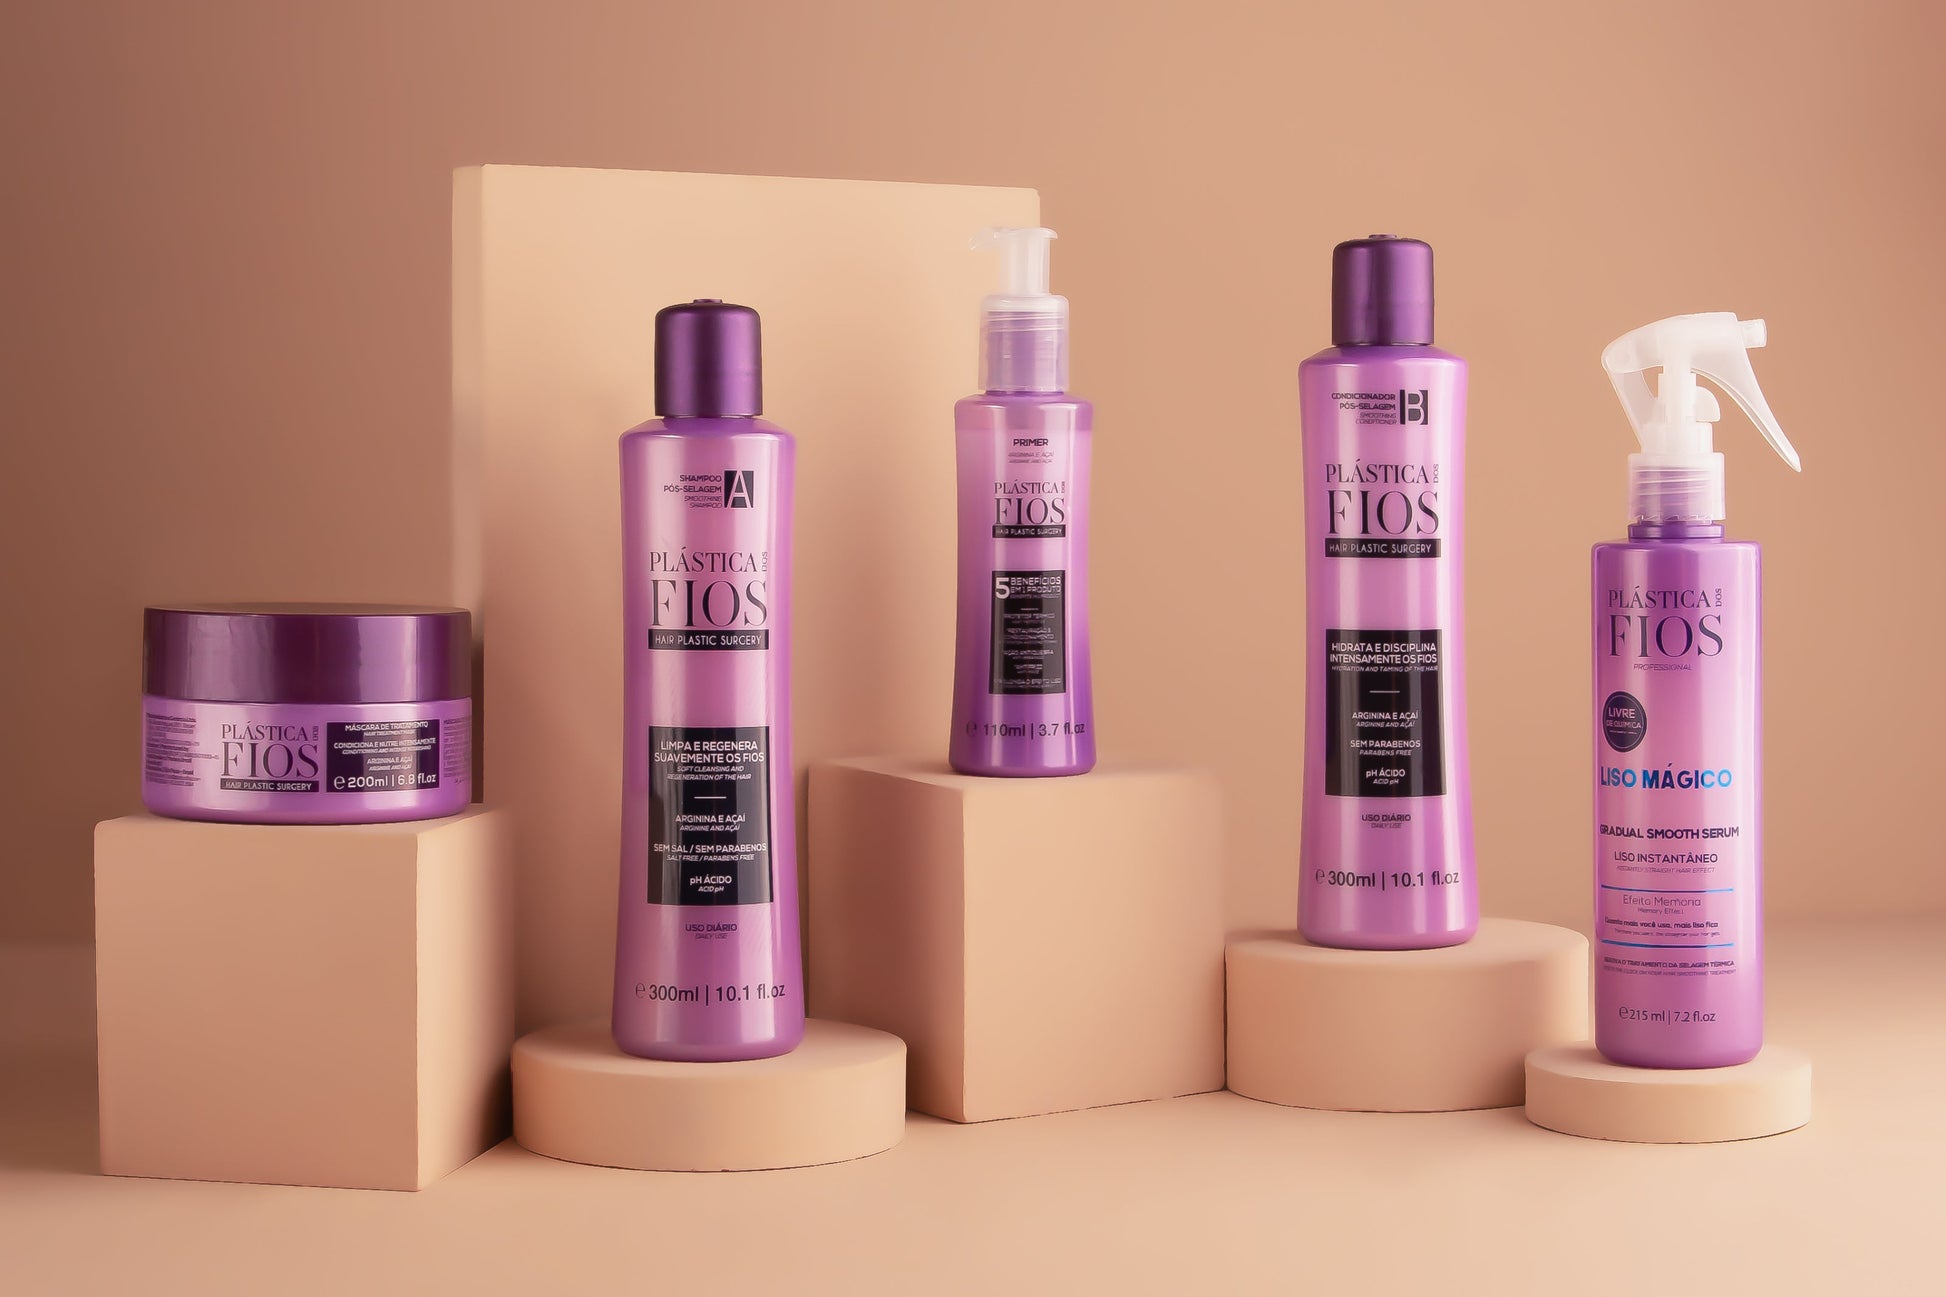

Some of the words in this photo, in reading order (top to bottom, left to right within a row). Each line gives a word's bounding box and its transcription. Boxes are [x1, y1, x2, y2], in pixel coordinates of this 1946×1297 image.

[1340, 402, 1395, 410] PÓS-SELAGEM
[1400, 390, 1428, 425] B
[1326, 459, 1429, 483] PLÁSTICA
[724, 471, 753, 508] A
[995, 479, 1058, 494] PLÁSTICA
[995, 498, 1064, 524] FIOS
[1328, 490, 1439, 534] FIOS
[1351, 544, 1387, 553] PLASTIC
[1392, 544, 1431, 553] SURGERY
[650, 547, 757, 572] PLÁSTICA
[996, 578, 1010, 599] 5
[1608, 585, 1711, 608] PLÁSTICA
[651, 580, 767, 626] FIOS
[656, 636, 674, 645] HAIR
[678, 636, 716, 645] PLASTIC
[721, 636, 761, 645] SURGERY
[1610, 615, 1722, 657] FIOS
[1332, 643, 1373, 652] HIDRATA
[1375, 644, 1381, 652] E
[1383, 643, 1436, 652] DISCIPLINA
[1330, 654, 1401, 663] INTENSAMENTE
[1402, 655, 1416, 663] OS
[1418, 654, 1437, 663] FIOS
[1399, 710, 1418, 721] AÇAÍ
[1609, 708, 1635, 718] LIVRE
[222, 721, 308, 741] PLÁSTICA
[391, 721, 428, 729] TRATAMENTO
[984, 724, 1025, 736] 110ml
[1039, 724, 1058, 736] 3.7
[661, 742, 692, 751] LIMPA
[694, 742, 700, 750] E
[703, 741, 758, 751] REGENERA
[1351, 740, 1367, 748] SEM
[1369, 740, 1421, 748] PARABENOS
[222, 742, 318, 778] FIOS
[655, 753, 724, 763] SUAVEMENTE
[726, 753, 740, 762] OS
[743, 752, 764, 762] FIOS
[1366, 769, 1377, 778] pH
[1379, 767, 1405, 777] ÁCIDO
[1601, 766, 1637, 787] LISO
[1642, 763, 1732, 789] MÁGICO
[244, 782, 274, 790] PLASTIC
[348, 776, 388, 788] 200ml
[398, 775, 415, 785] 6.8
[418, 773, 436, 784] fl.oz
[675, 815, 716, 823] ARGININA
[719, 815, 723, 823] E
[726, 813, 745, 825] AÇAÍ
[1600, 824, 1644, 838] GRADUAL
[1647, 829, 1699, 839] SMOOTH
[1702, 827, 1739, 838] SERUM
[716, 843, 766, 852] PARABENOS
[1615, 851, 1635, 862] LISO
[1638, 852, 1718, 863] INSTANTÂNEO
[690, 876, 702, 885] pH
[704, 874, 732, 884] ÁCIDO
[1328, 871, 1375, 887] 300ml
[1392, 872, 1424, 887] 10.1
[1432, 871, 1459, 885] fl.oz
[1623, 895, 1651, 905] Efeito
[686, 924, 704, 932] USO
[707, 922, 737, 932] DIÁRIO
[649, 985, 698, 1001] 300ml
[716, 985, 749, 1001] 10.1
[757, 984, 785, 999] fl.oz
[1651, 1011, 1664, 1021] ml
[1693, 1011, 1716, 1022] fl.oz
